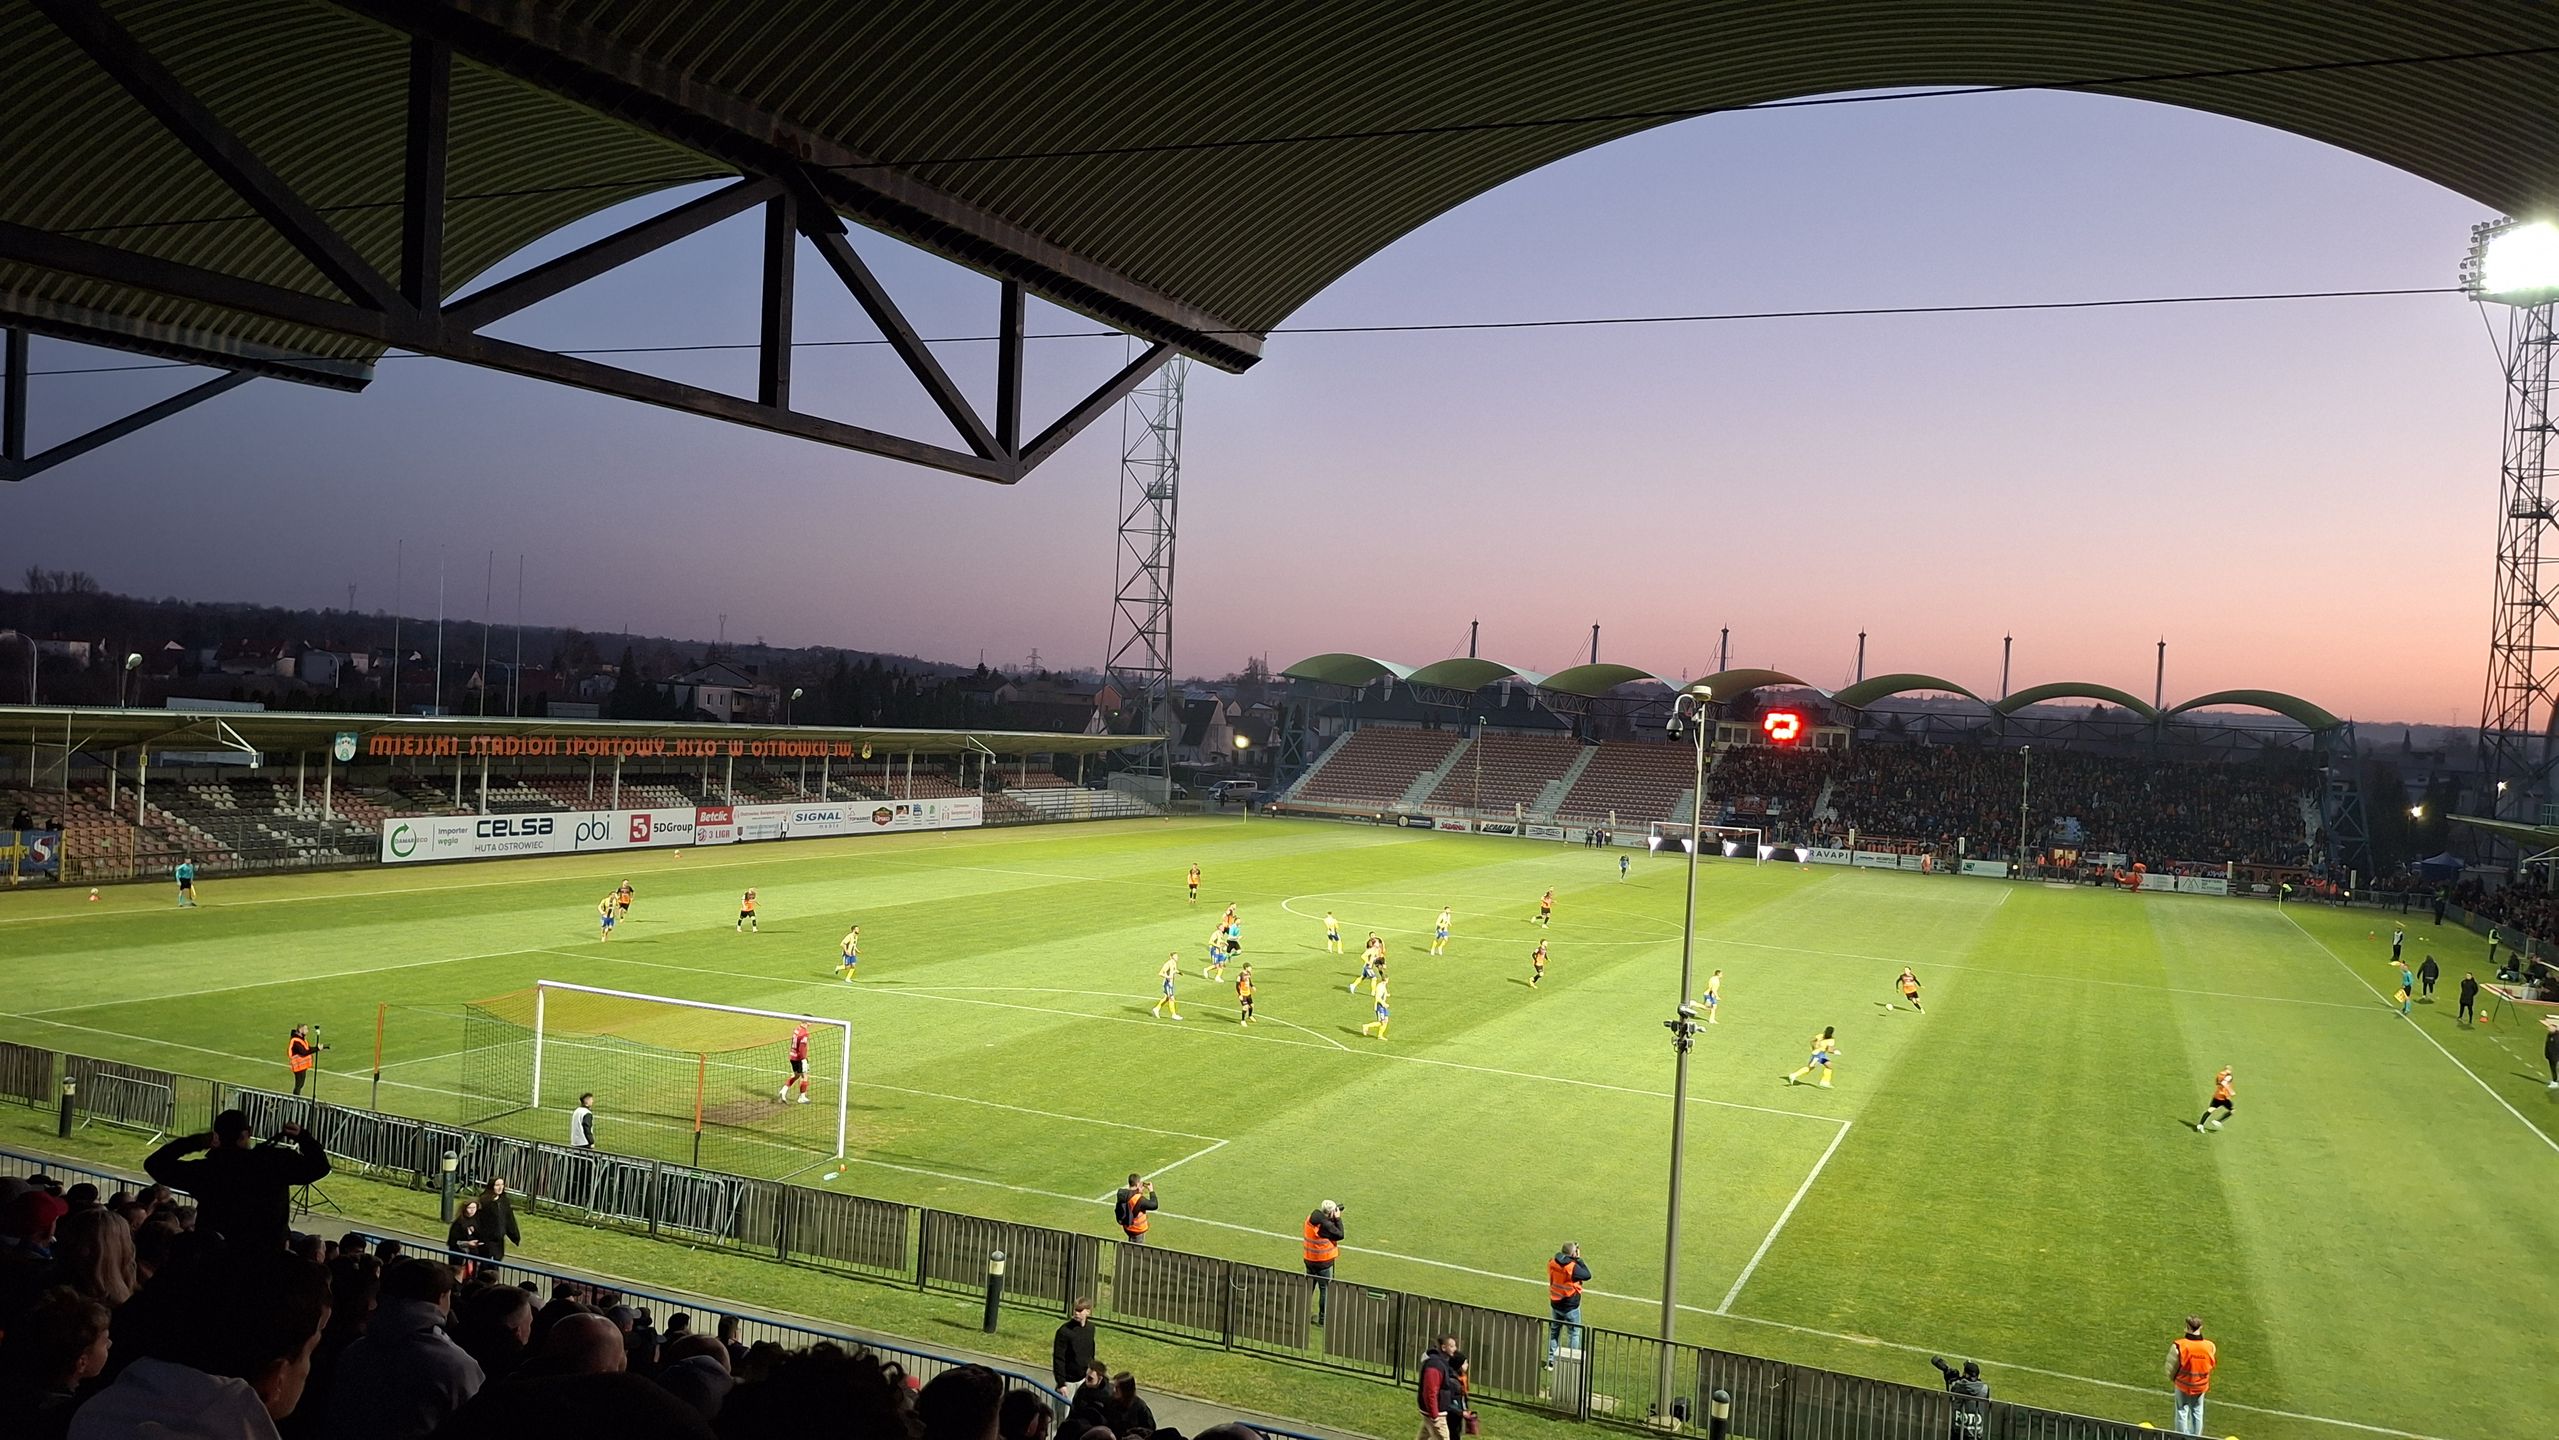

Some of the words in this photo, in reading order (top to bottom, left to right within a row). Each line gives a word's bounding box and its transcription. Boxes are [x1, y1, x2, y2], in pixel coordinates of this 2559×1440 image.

[369, 735, 458, 757] MIEJSKI
[469, 735, 557, 757] STADION
[566, 737, 665, 757] SPORTOWY
[729, 740, 744, 757] W
[752, 740, 829, 758] OSTROWCU
[700, 811, 728, 824] Betclic
[795, 810, 842, 822] SIGNAL
[438, 827, 468, 837] Importer
[653, 822, 693, 836] 5DGroup
[708, 830, 713, 839] 3
[716, 829, 730, 838] LIGA
[474, 843, 496, 853] HUTA
[498, 840, 543, 851] OSTROWIEC
[1955, 1409, 1982, 1425] FOTO
